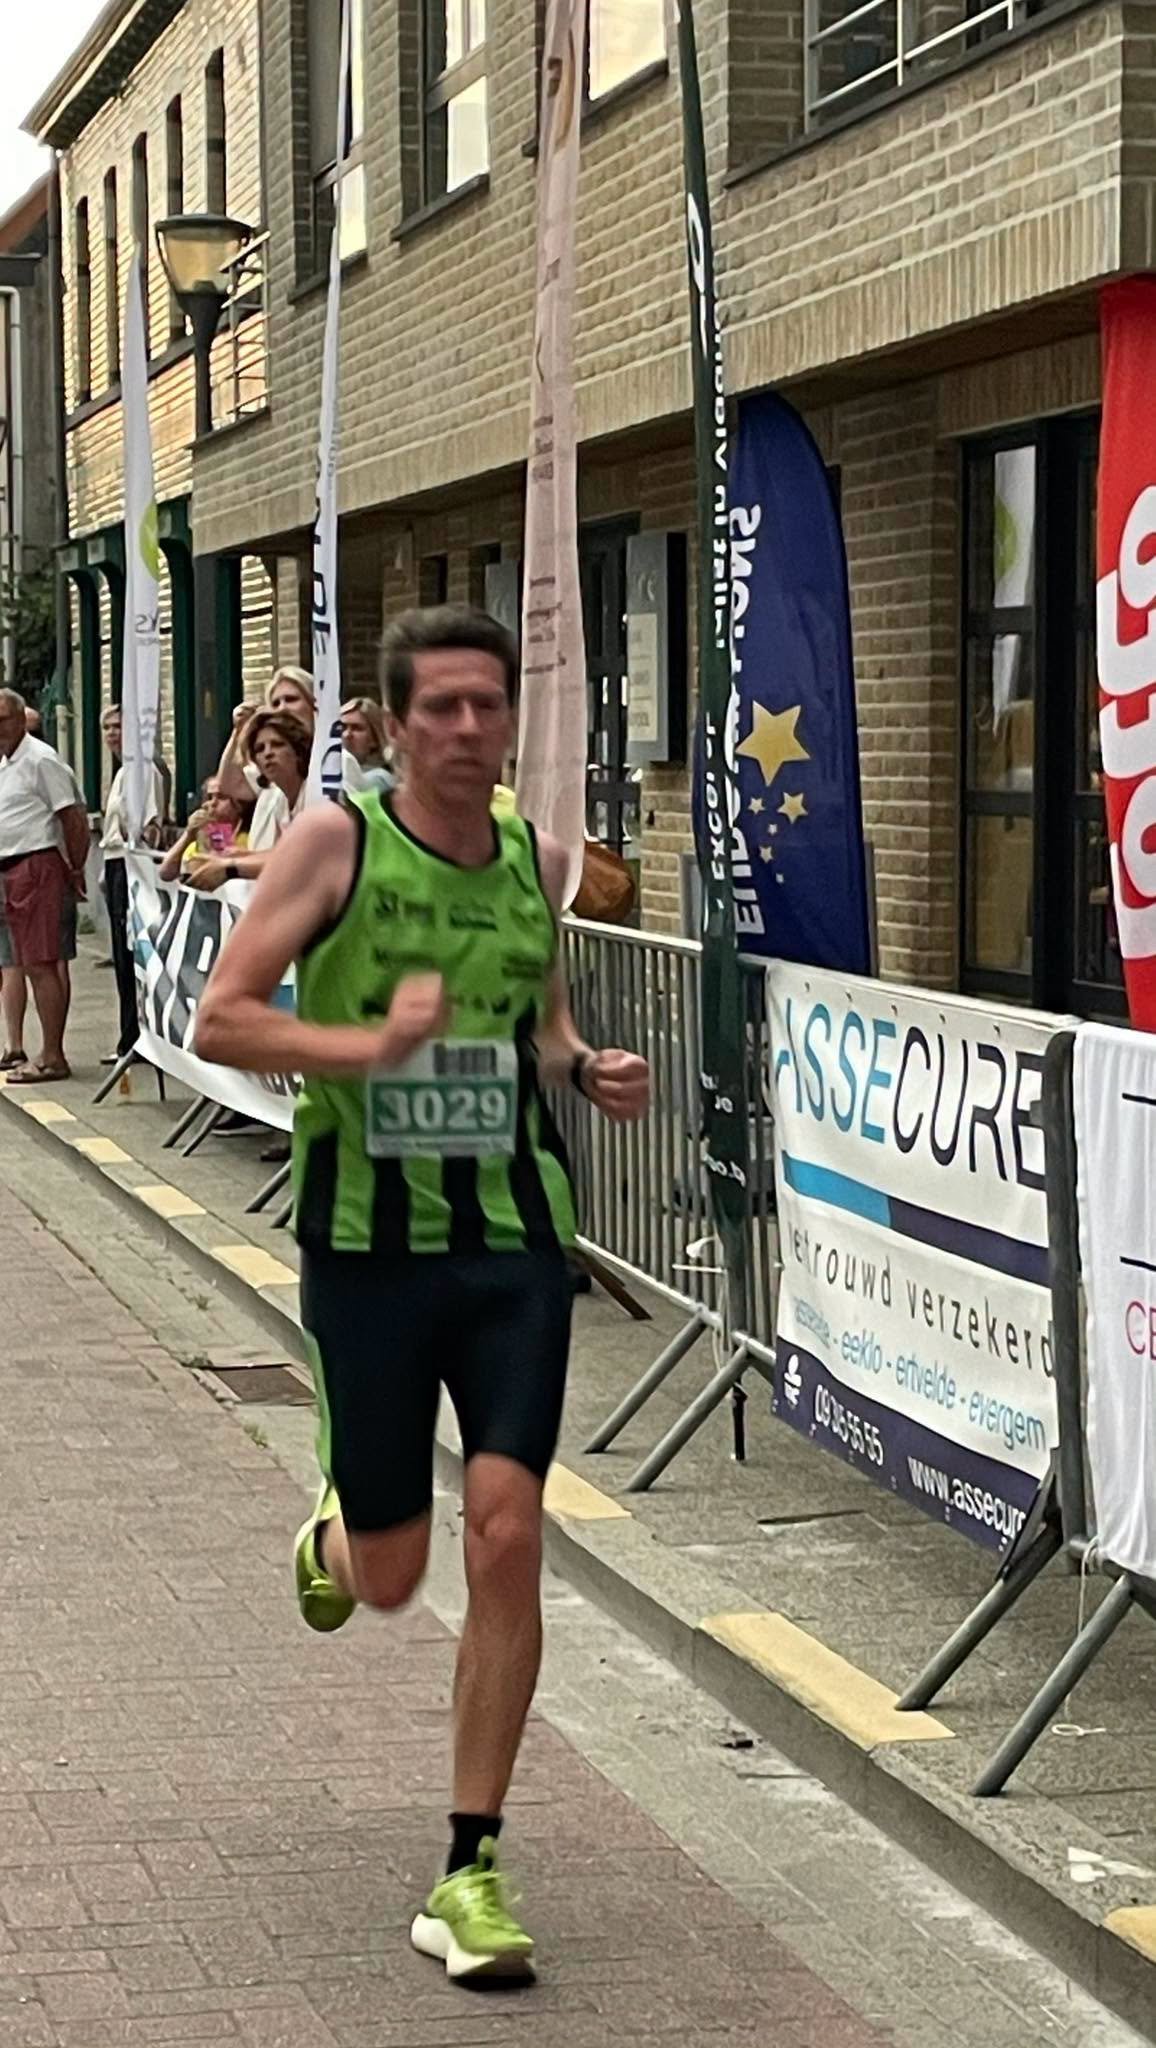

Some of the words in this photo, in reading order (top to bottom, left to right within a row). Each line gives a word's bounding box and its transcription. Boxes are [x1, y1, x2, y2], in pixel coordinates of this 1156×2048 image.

[376, 1086, 507, 1132] 3029
[840, 1328, 883, 1374] eeklo
[895, 1354, 958, 1410] ertvelde
[968, 1388, 1047, 1452] evergem
